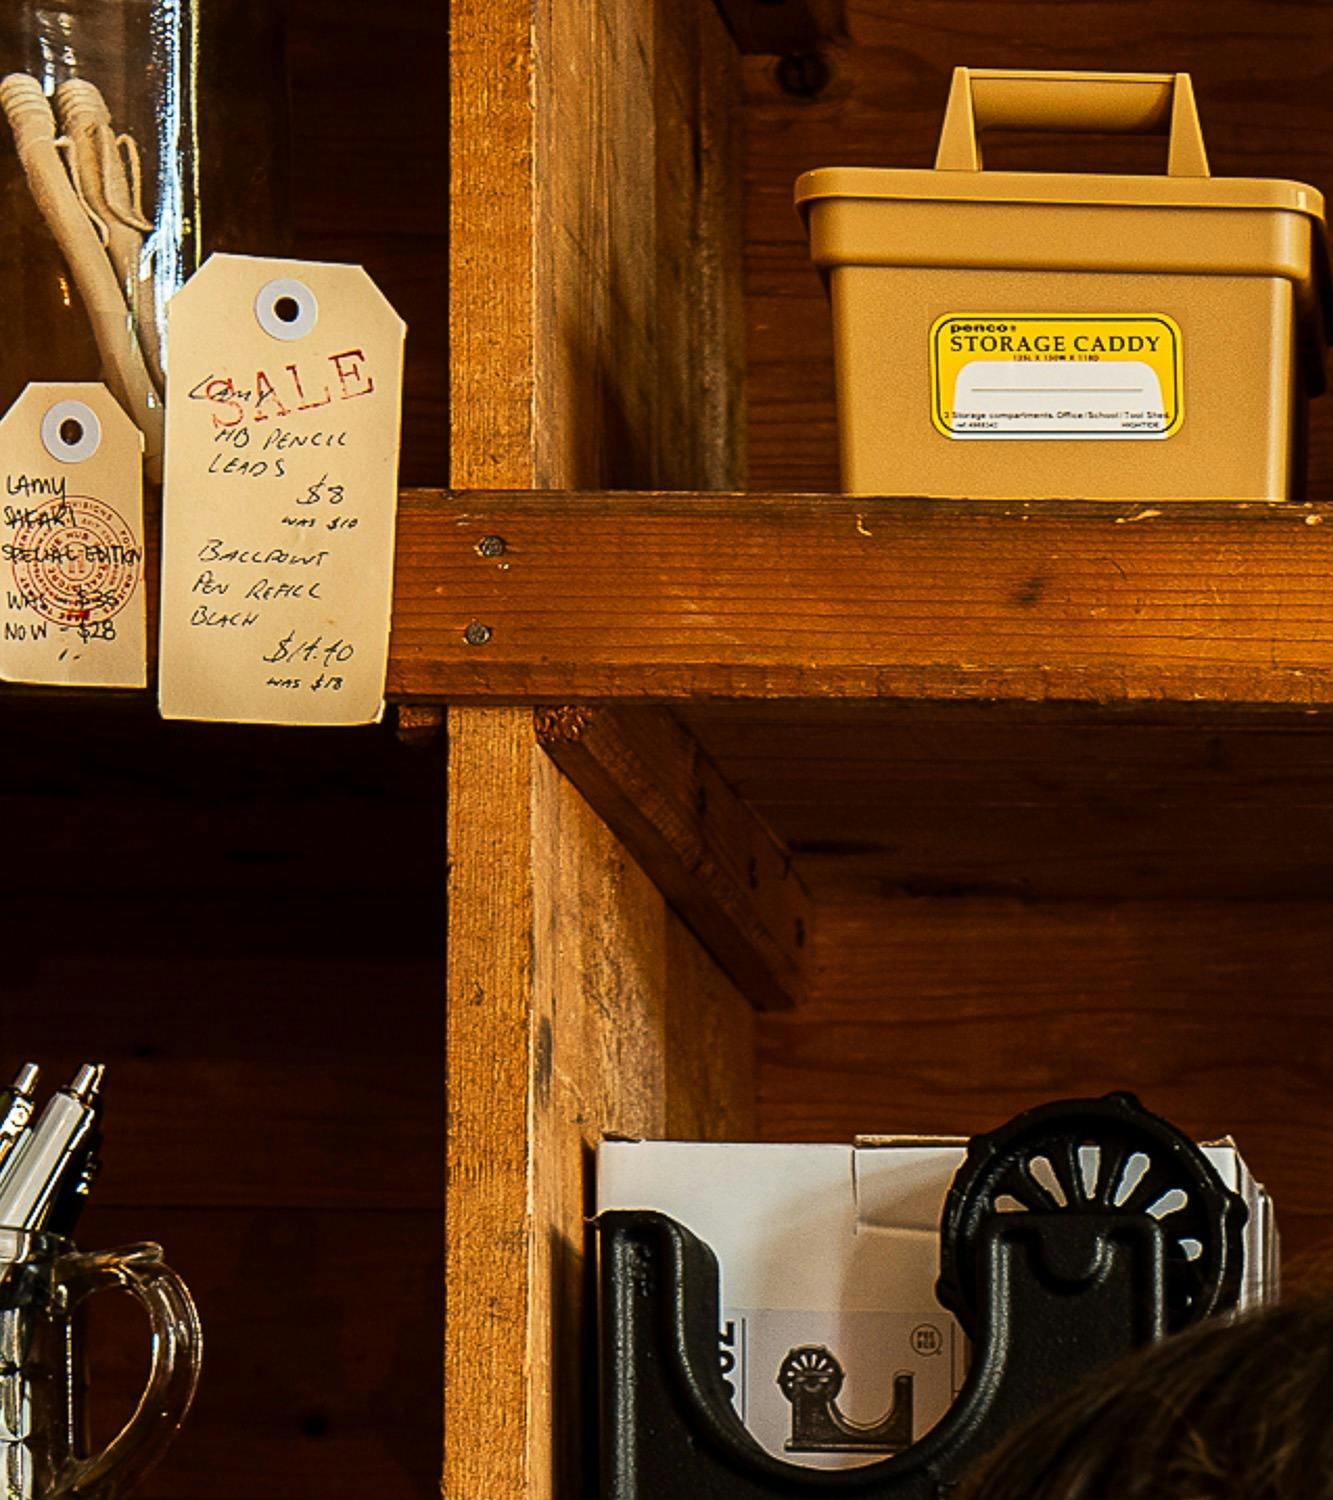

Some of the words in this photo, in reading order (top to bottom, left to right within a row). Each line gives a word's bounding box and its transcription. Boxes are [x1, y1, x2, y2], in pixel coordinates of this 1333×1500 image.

[951, 335, 1066, 352] STORAGE
[1074, 336, 1160, 352] CADDY
[206, 349, 374, 428] SALE
[263, 428, 348, 450] PENCIL
[208, 453, 285, 477] LEADS
[296, 473, 345, 505] $8
[326, 516, 358, 530] $10
[192, 570, 229, 595] PEN
[5, 621, 48, 641] NOW
[76, 617, 116, 644] $28
[311, 673, 344, 691] $18
